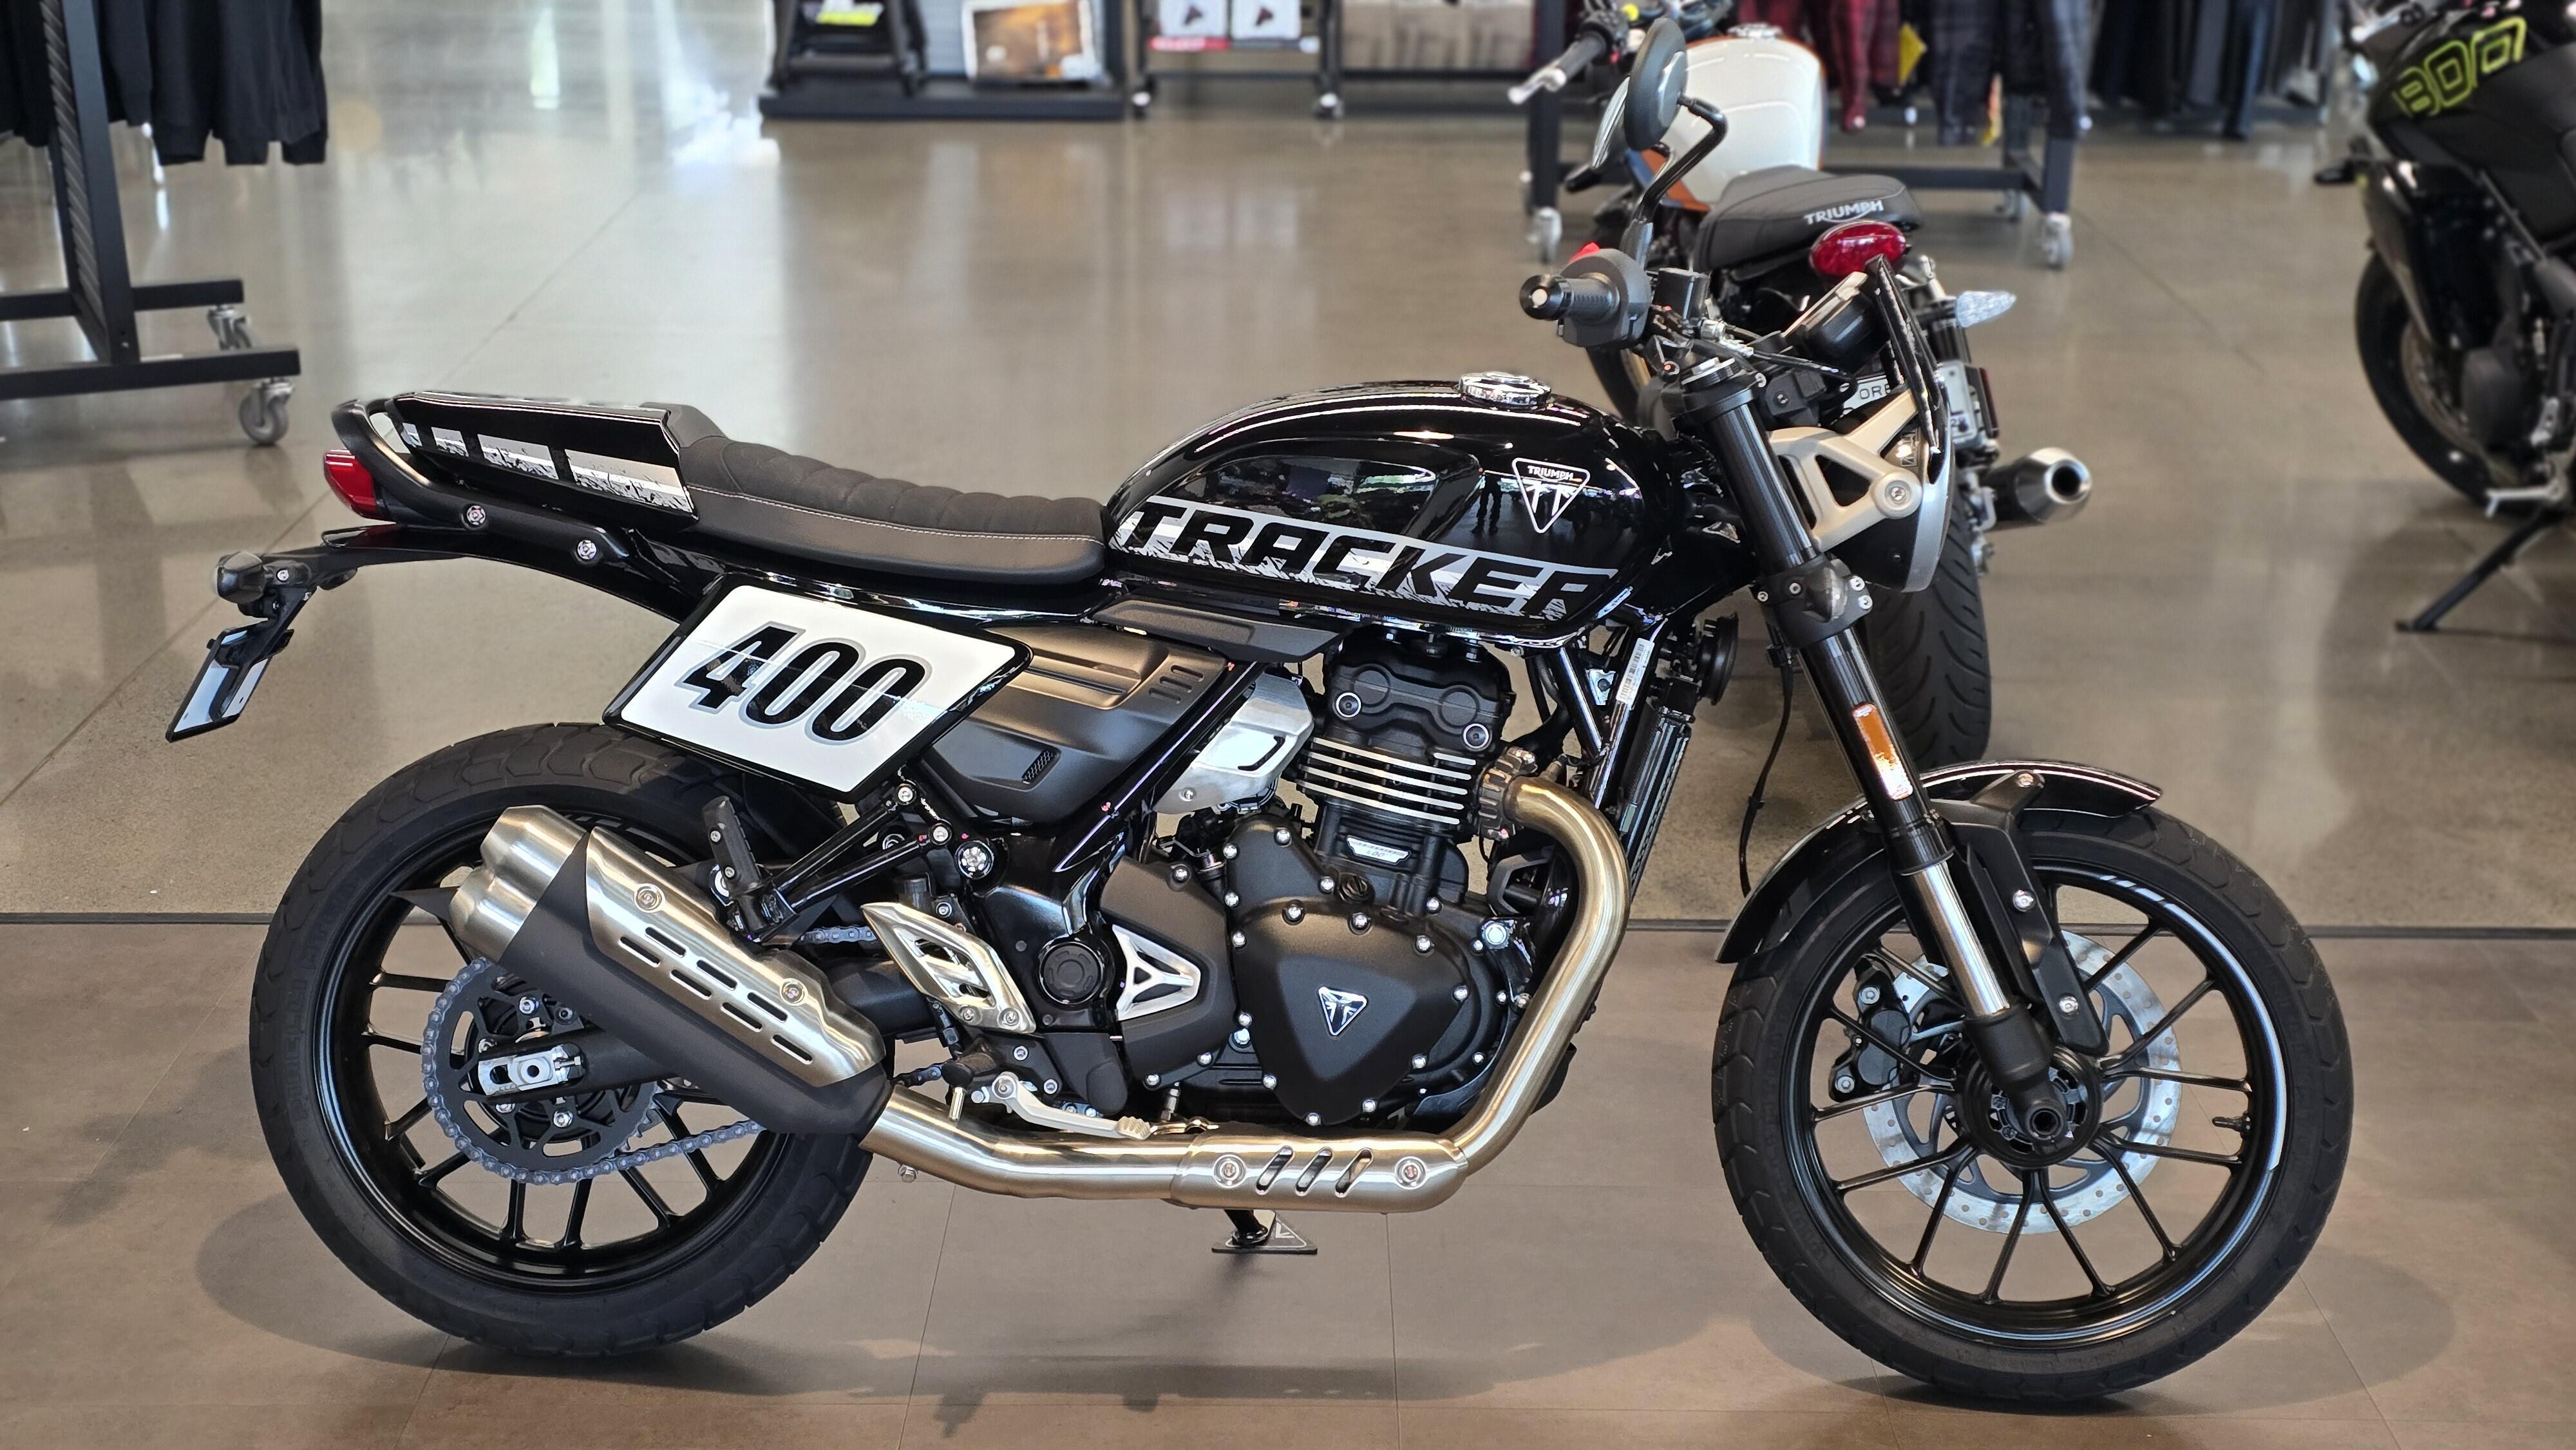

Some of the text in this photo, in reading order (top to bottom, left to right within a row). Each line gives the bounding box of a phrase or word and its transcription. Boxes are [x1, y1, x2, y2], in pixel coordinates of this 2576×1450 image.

[1803, 200, 1884, 225] TRIUMPH
[1527, 465, 1574, 482] TRIUMPH
[1119, 504, 1613, 617] TRACKER
[675, 621, 933, 744] 400
